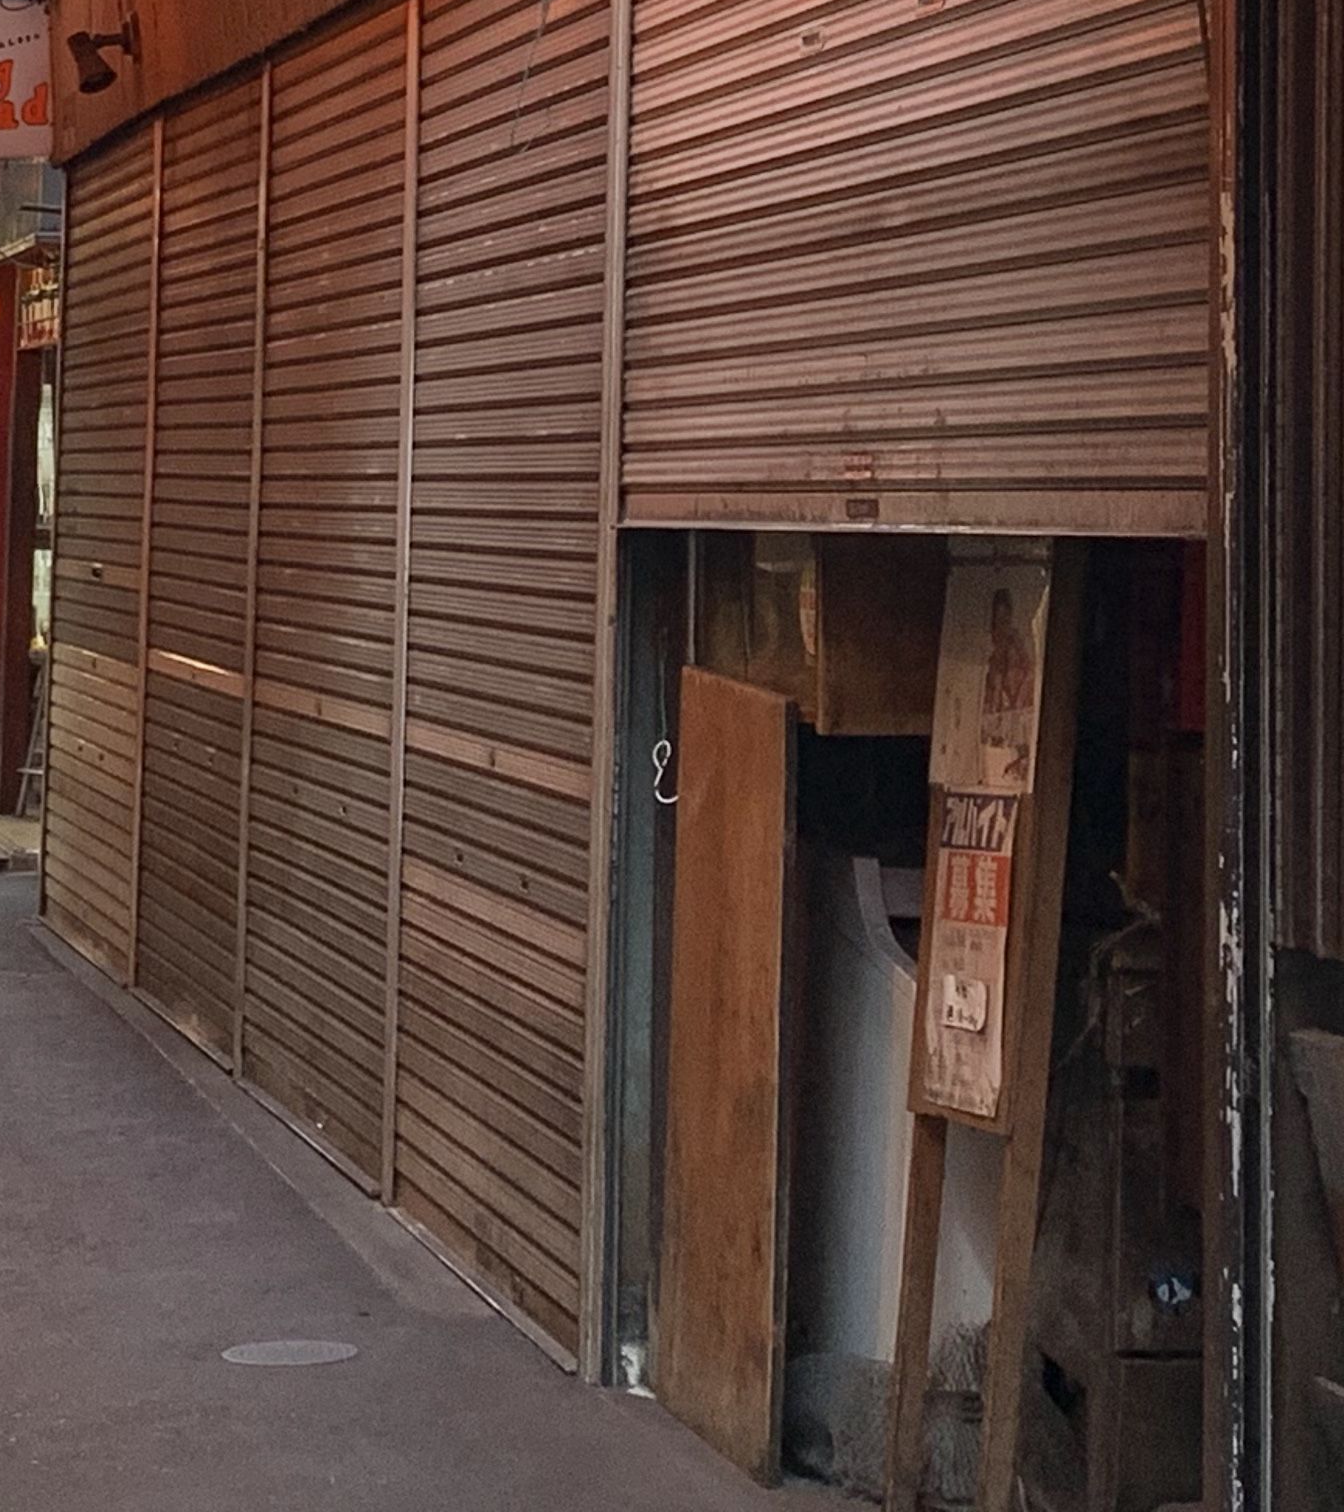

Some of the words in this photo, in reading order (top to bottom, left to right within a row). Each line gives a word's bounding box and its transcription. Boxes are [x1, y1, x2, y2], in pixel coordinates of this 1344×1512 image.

[942, 796, 1007, 849] アルバイト
[948, 855, 998, 923] 募集
